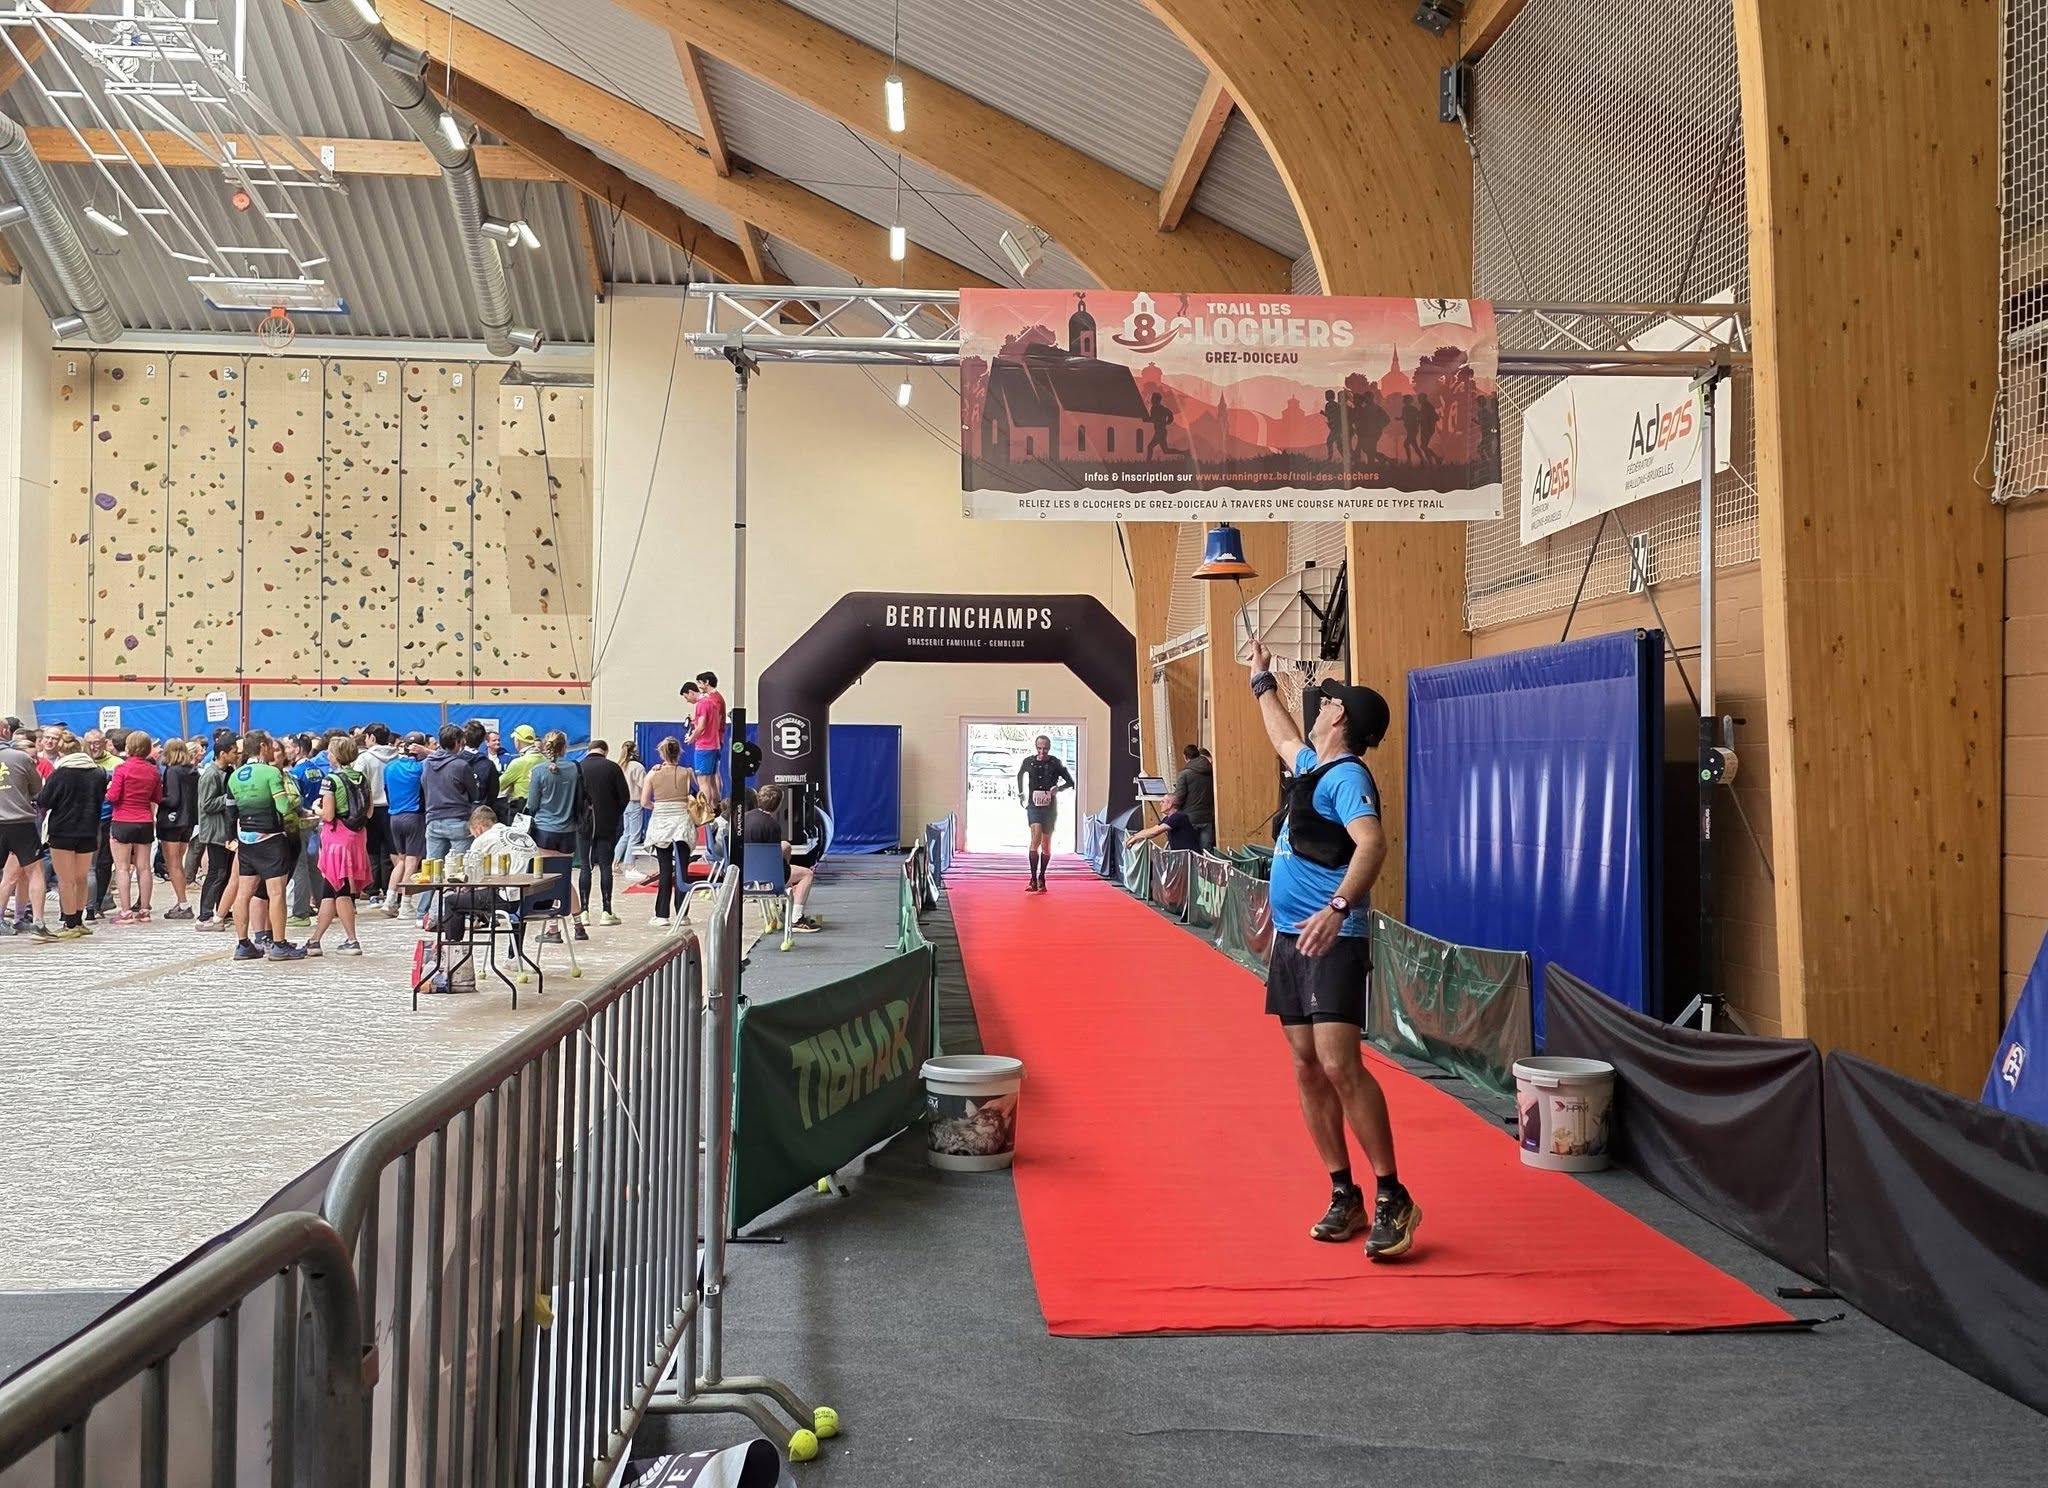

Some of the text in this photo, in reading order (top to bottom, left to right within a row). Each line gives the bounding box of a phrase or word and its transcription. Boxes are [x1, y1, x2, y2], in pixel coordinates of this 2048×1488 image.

[1206, 302, 1292, 316] TRAIL DES
[1133, 313, 1355, 348] 8 CLOCHERS
[1205, 351, 1299, 364] GREZ-DOICEAU
[68, 363, 75, 373] 1
[147, 366, 154, 376] 2
[224, 367, 231, 378] 3
[300, 370, 308, 379] 4
[378, 372, 385, 382] 5
[516, 397, 522, 407] 7
[1628, 400, 1692, 460] Adeps
[1084, 471, 1380, 484] Infos & inscription sur www.runningrez.be/trail-des-clochers
[1532, 457, 1570, 505] Adeps
[1019, 496, 1444, 508] RELIEZ LES 8 CLOCHERS DE GREZ-DOICEAU À TRAVERS UNE COURSE NATURE DE TYPE TRAIL
[886, 605, 1052, 630] BERTINCHAMPS
[908, 638, 944, 646] BRASSERIE
[946, 638, 981, 647] FAMILIALE
[989, 639, 1025, 648] GEMBLOUX
[782, 727, 801, 749] B
[790, 999, 914, 1130] TIBHAR
